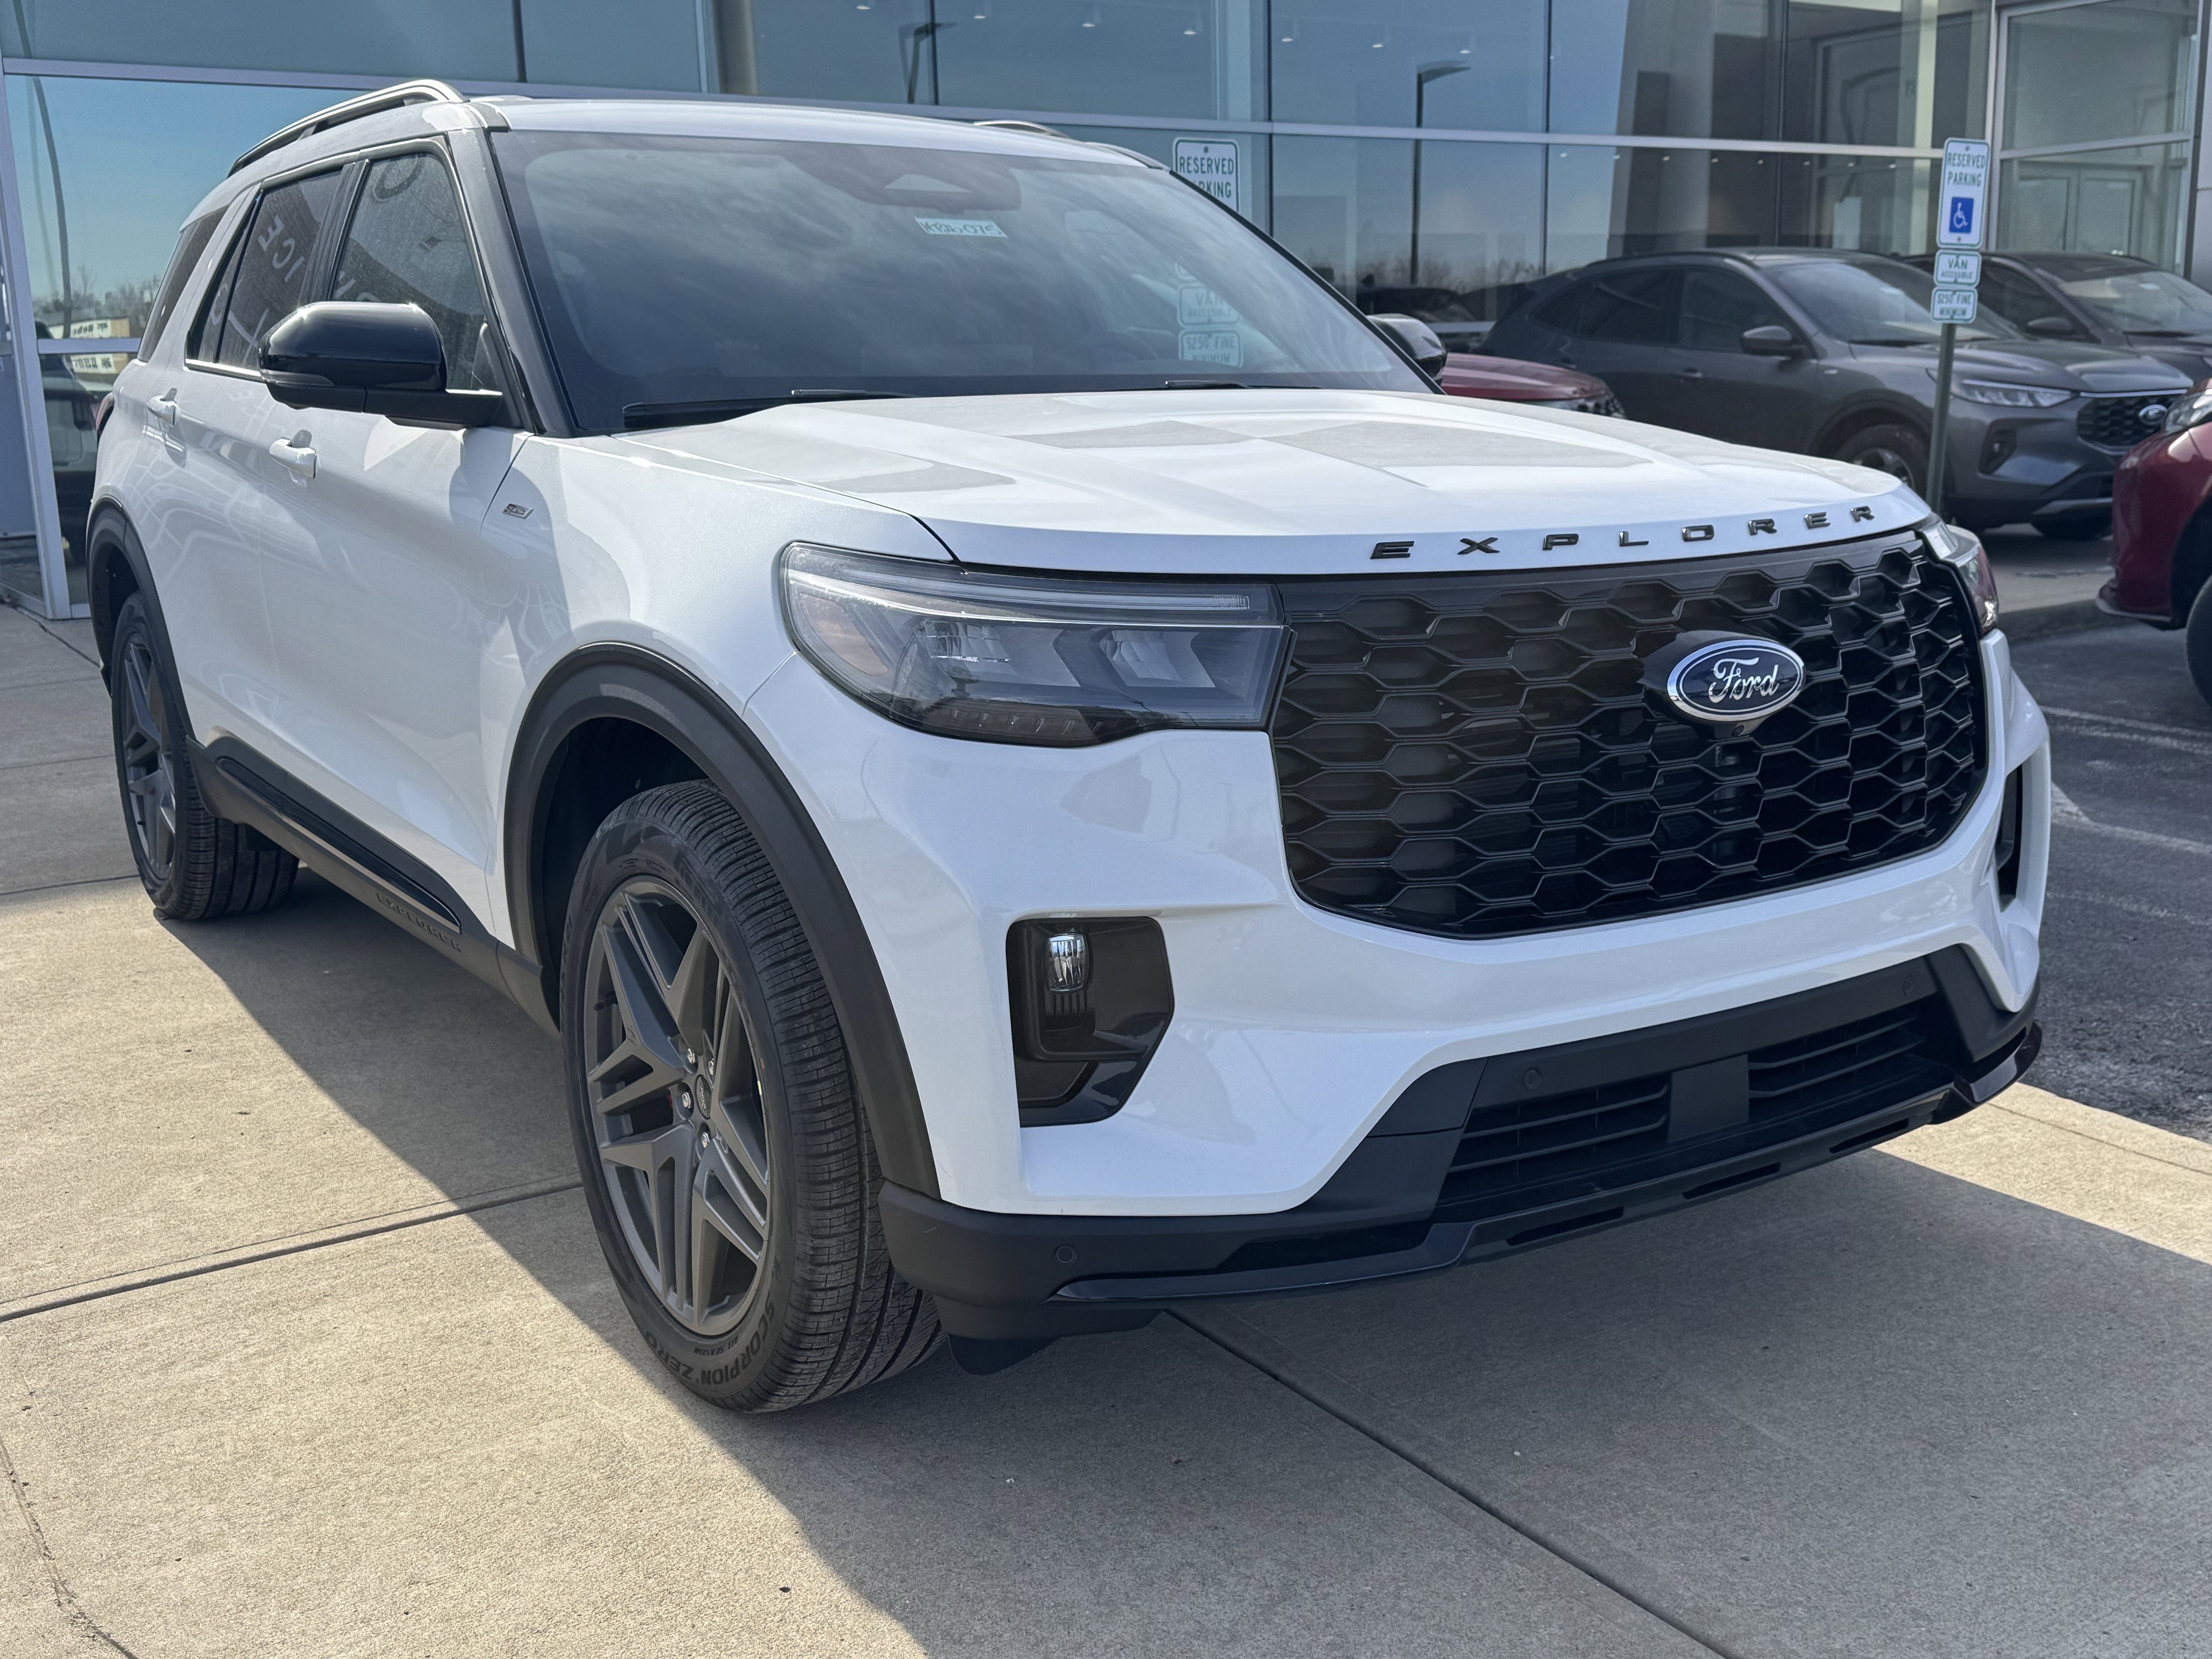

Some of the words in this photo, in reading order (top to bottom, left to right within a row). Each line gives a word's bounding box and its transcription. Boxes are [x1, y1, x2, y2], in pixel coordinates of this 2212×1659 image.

[1179, 156, 1234, 174] RESERVED
[1947, 152, 1985, 168] RESERVED
[1947, 170, 1982, 187] PARKING
[1948, 258, 1968, 270] VAN
[1214, 335, 1235, 350] FINE
[1370, 505, 1875, 560] EXPLORER
[1708, 657, 1780, 704] Ford
[376, 893, 461, 952] EXPLORER
[701, 1290, 775, 1385] SCORPION
[646, 1331, 694, 1380] ZERO
[694, 1346, 725, 1356] SEASON
